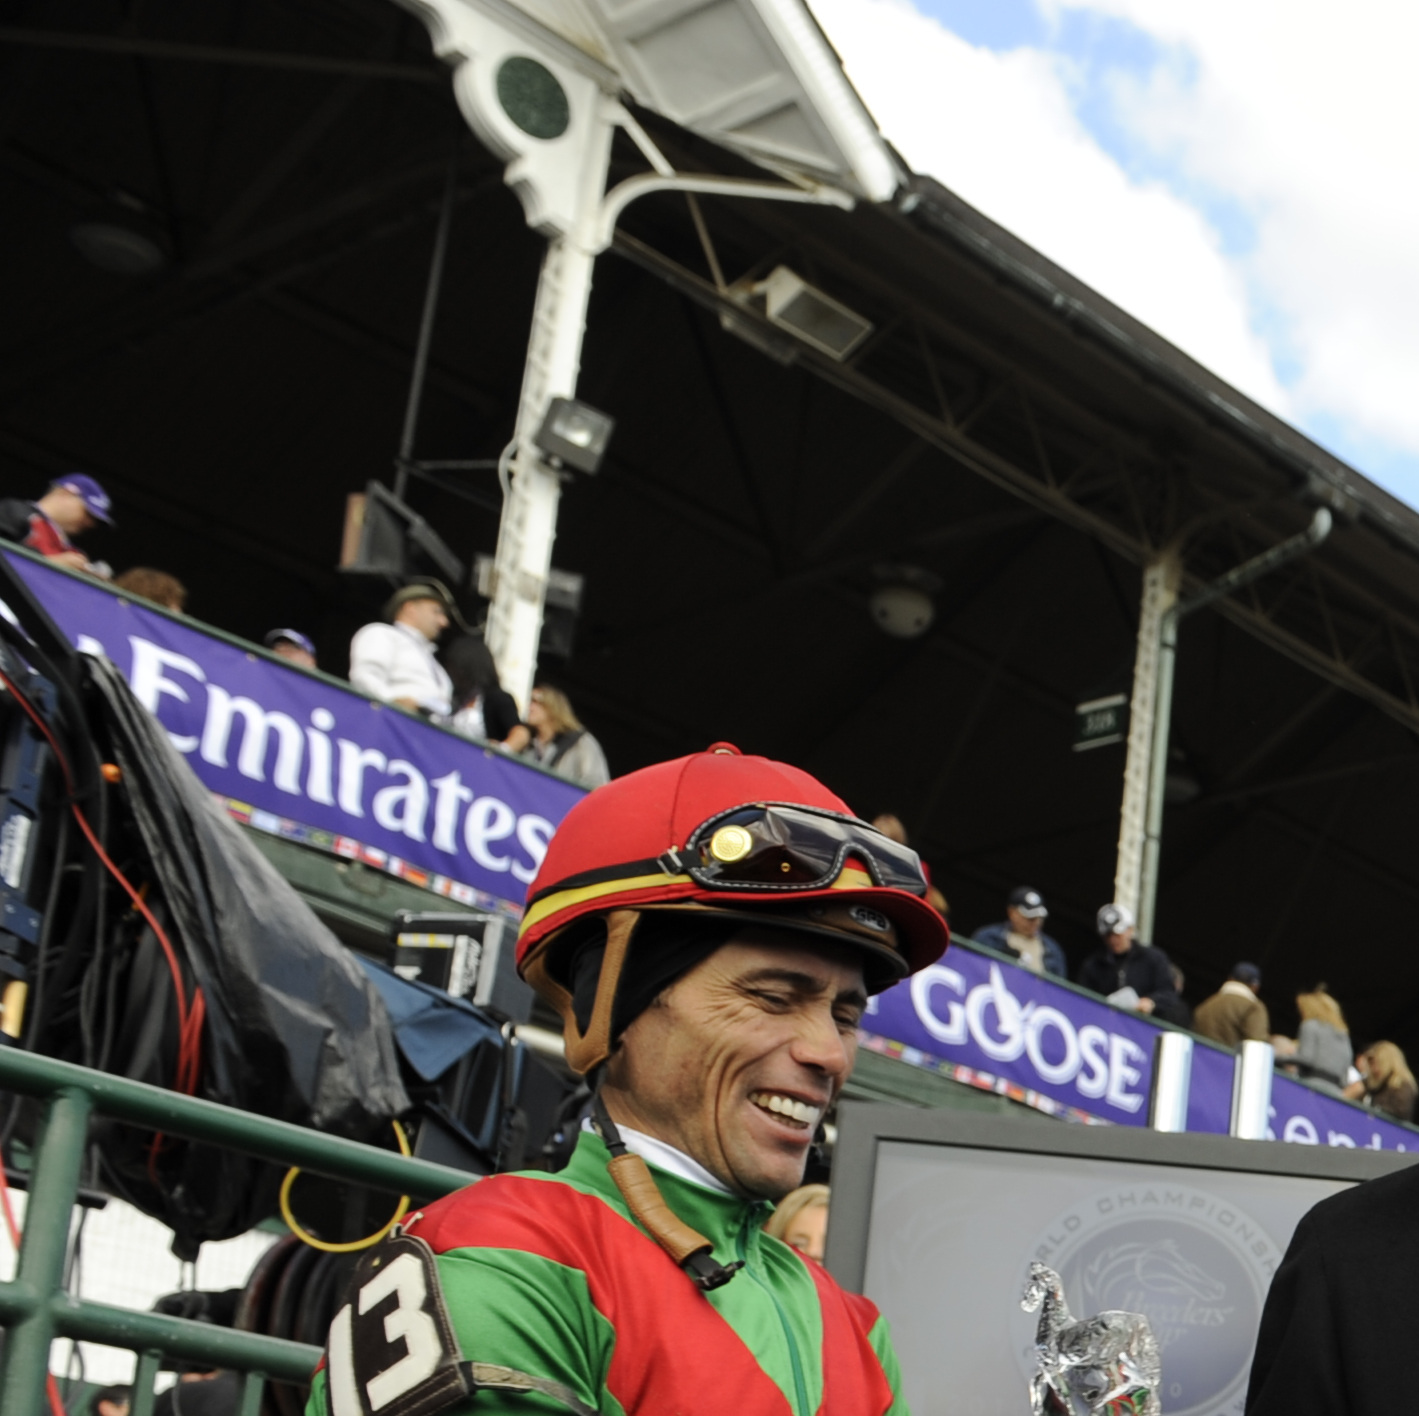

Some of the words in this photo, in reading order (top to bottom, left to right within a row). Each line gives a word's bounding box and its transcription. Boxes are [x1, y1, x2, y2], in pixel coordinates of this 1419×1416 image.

[127, 634, 556, 887] Emirates
[910, 961, 1147, 1114] GOOSE
[1036, 1214, 1082, 1261] RLD
